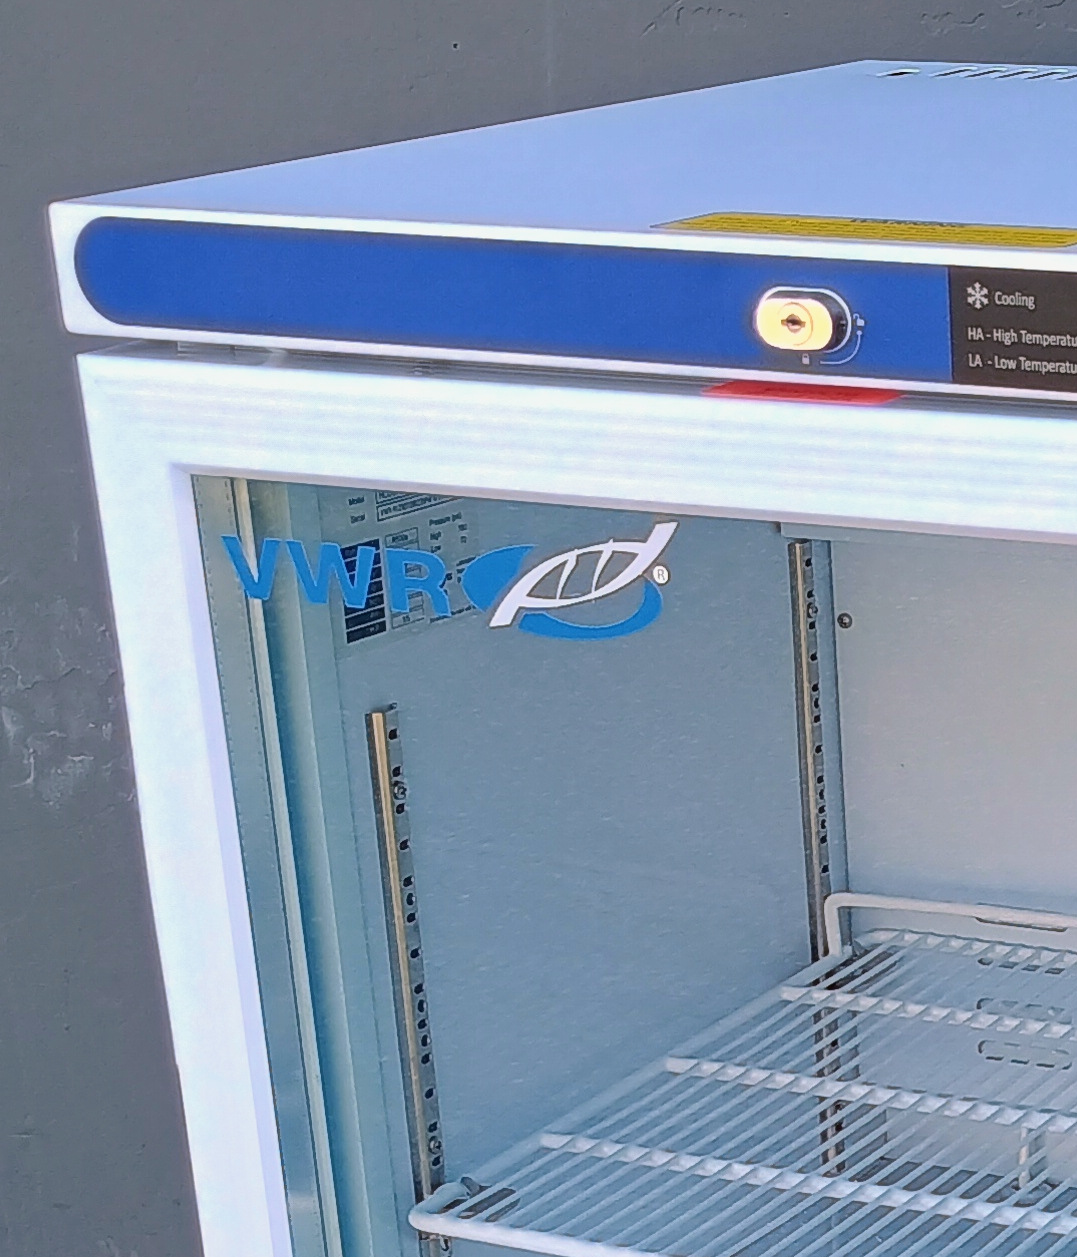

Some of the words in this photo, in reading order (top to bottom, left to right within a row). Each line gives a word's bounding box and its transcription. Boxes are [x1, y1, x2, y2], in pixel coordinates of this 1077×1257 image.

[994, 291, 1036, 309] Cooling
[967, 327, 985, 342] HA
[993, 328, 1018, 346] High
[968, 354, 983, 368] LA
[994, 356, 1017, 370] Low
[221, 535, 451, 616] VWR
